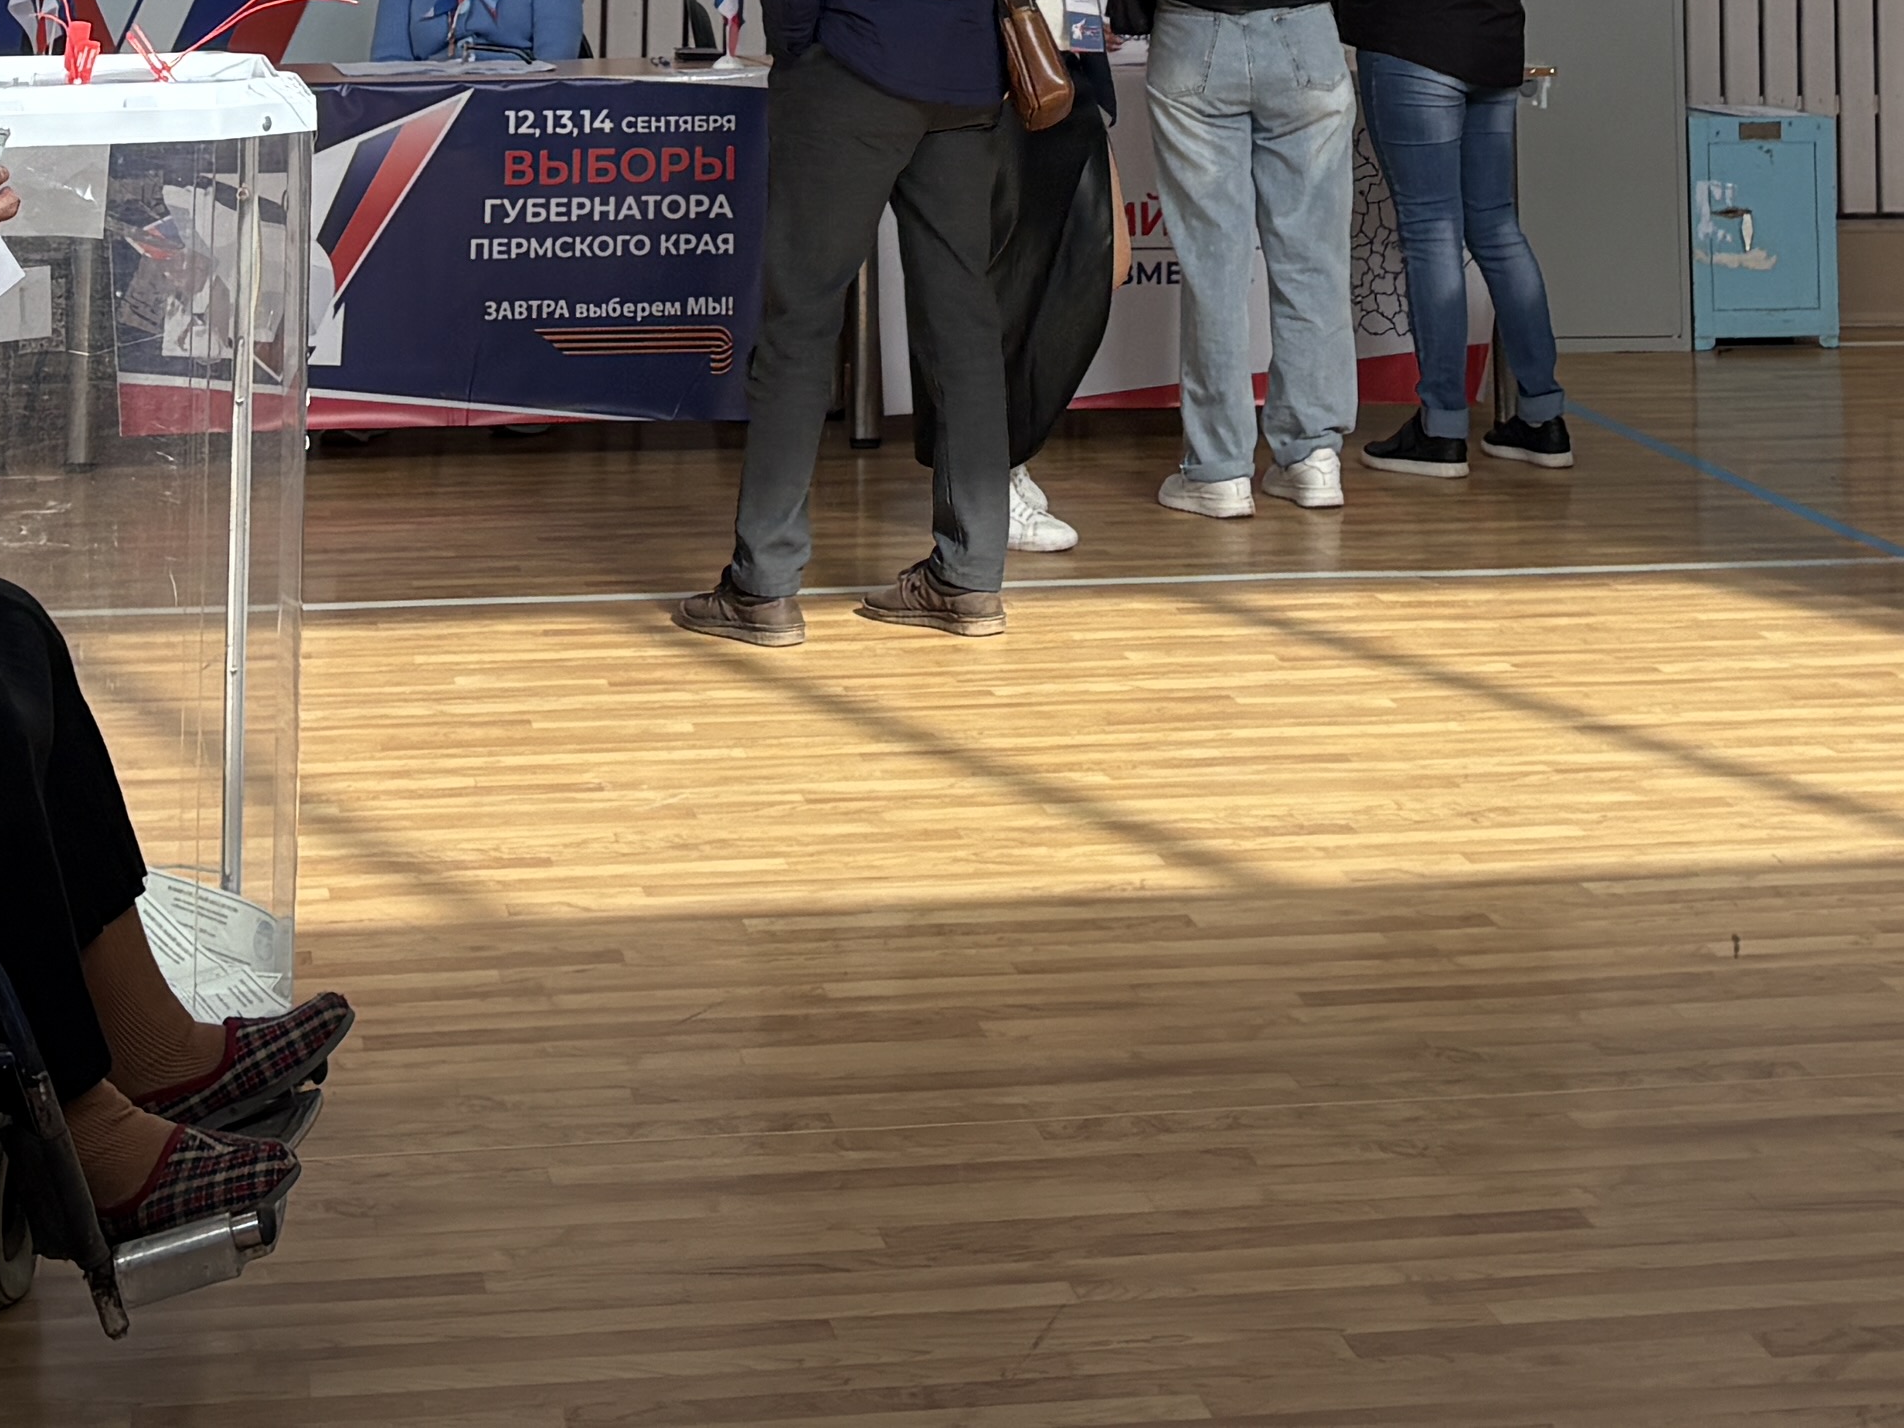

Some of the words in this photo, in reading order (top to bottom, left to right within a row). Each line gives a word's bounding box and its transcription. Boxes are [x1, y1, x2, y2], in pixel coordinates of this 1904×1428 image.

[504, 109, 614, 138] 12,13,14
[621, 115, 737, 133] СЕНТЯБРЯ
[503, 145, 736, 187] ВЫБОРЫ
[484, 194, 734, 224] ГУБЕРНАТОРА
[469, 234, 652, 260] ПЕРМСКОГО
[659, 233, 736, 256] КРАЯ
[484, 299, 570, 321] ЗАВТРА
[575, 297, 681, 322] выберем
[687, 296, 734, 316] МЫ!
